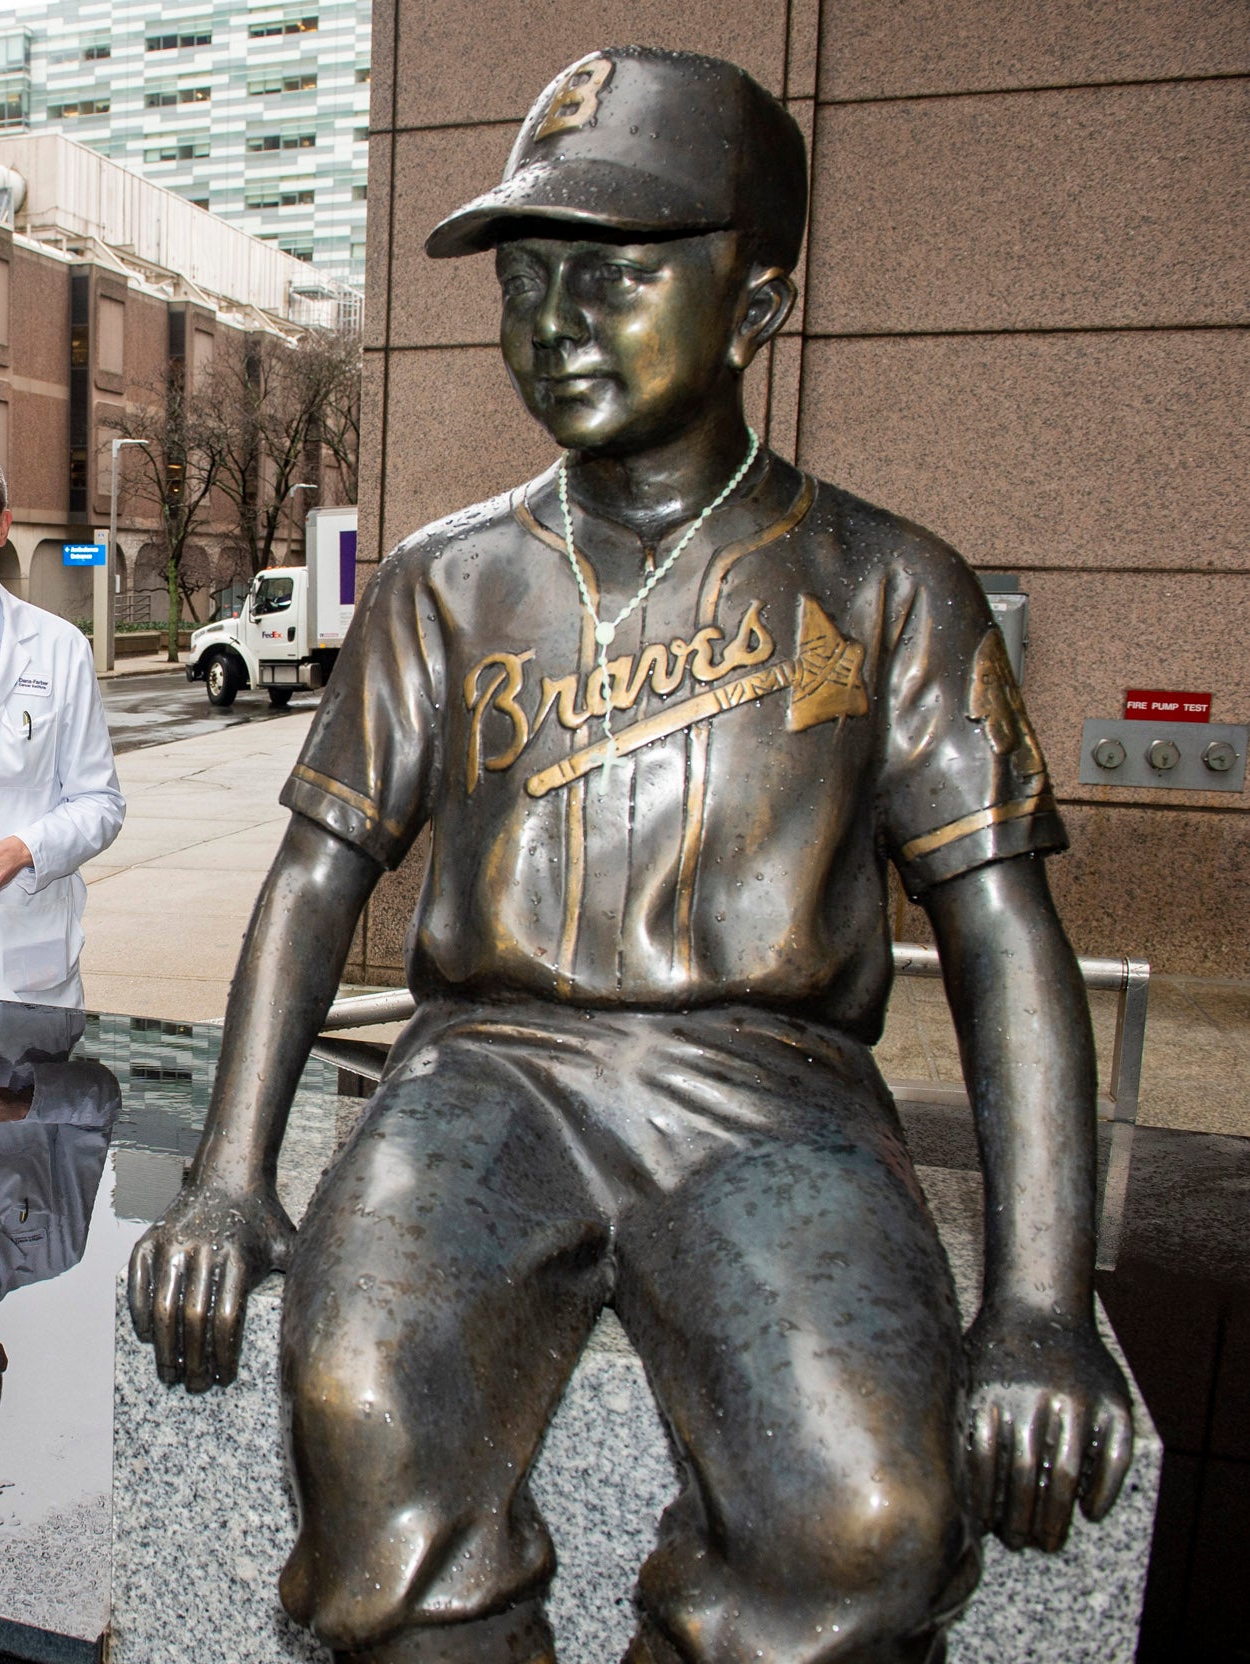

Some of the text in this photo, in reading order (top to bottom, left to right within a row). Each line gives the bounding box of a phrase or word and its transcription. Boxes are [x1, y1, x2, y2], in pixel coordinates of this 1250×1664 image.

[534, 59, 612, 141] B
[261, 631, 283, 639] FedEx
[464, 599, 775, 796] Braves
[1127, 701, 1209, 713] FIRE PUMP TEST
